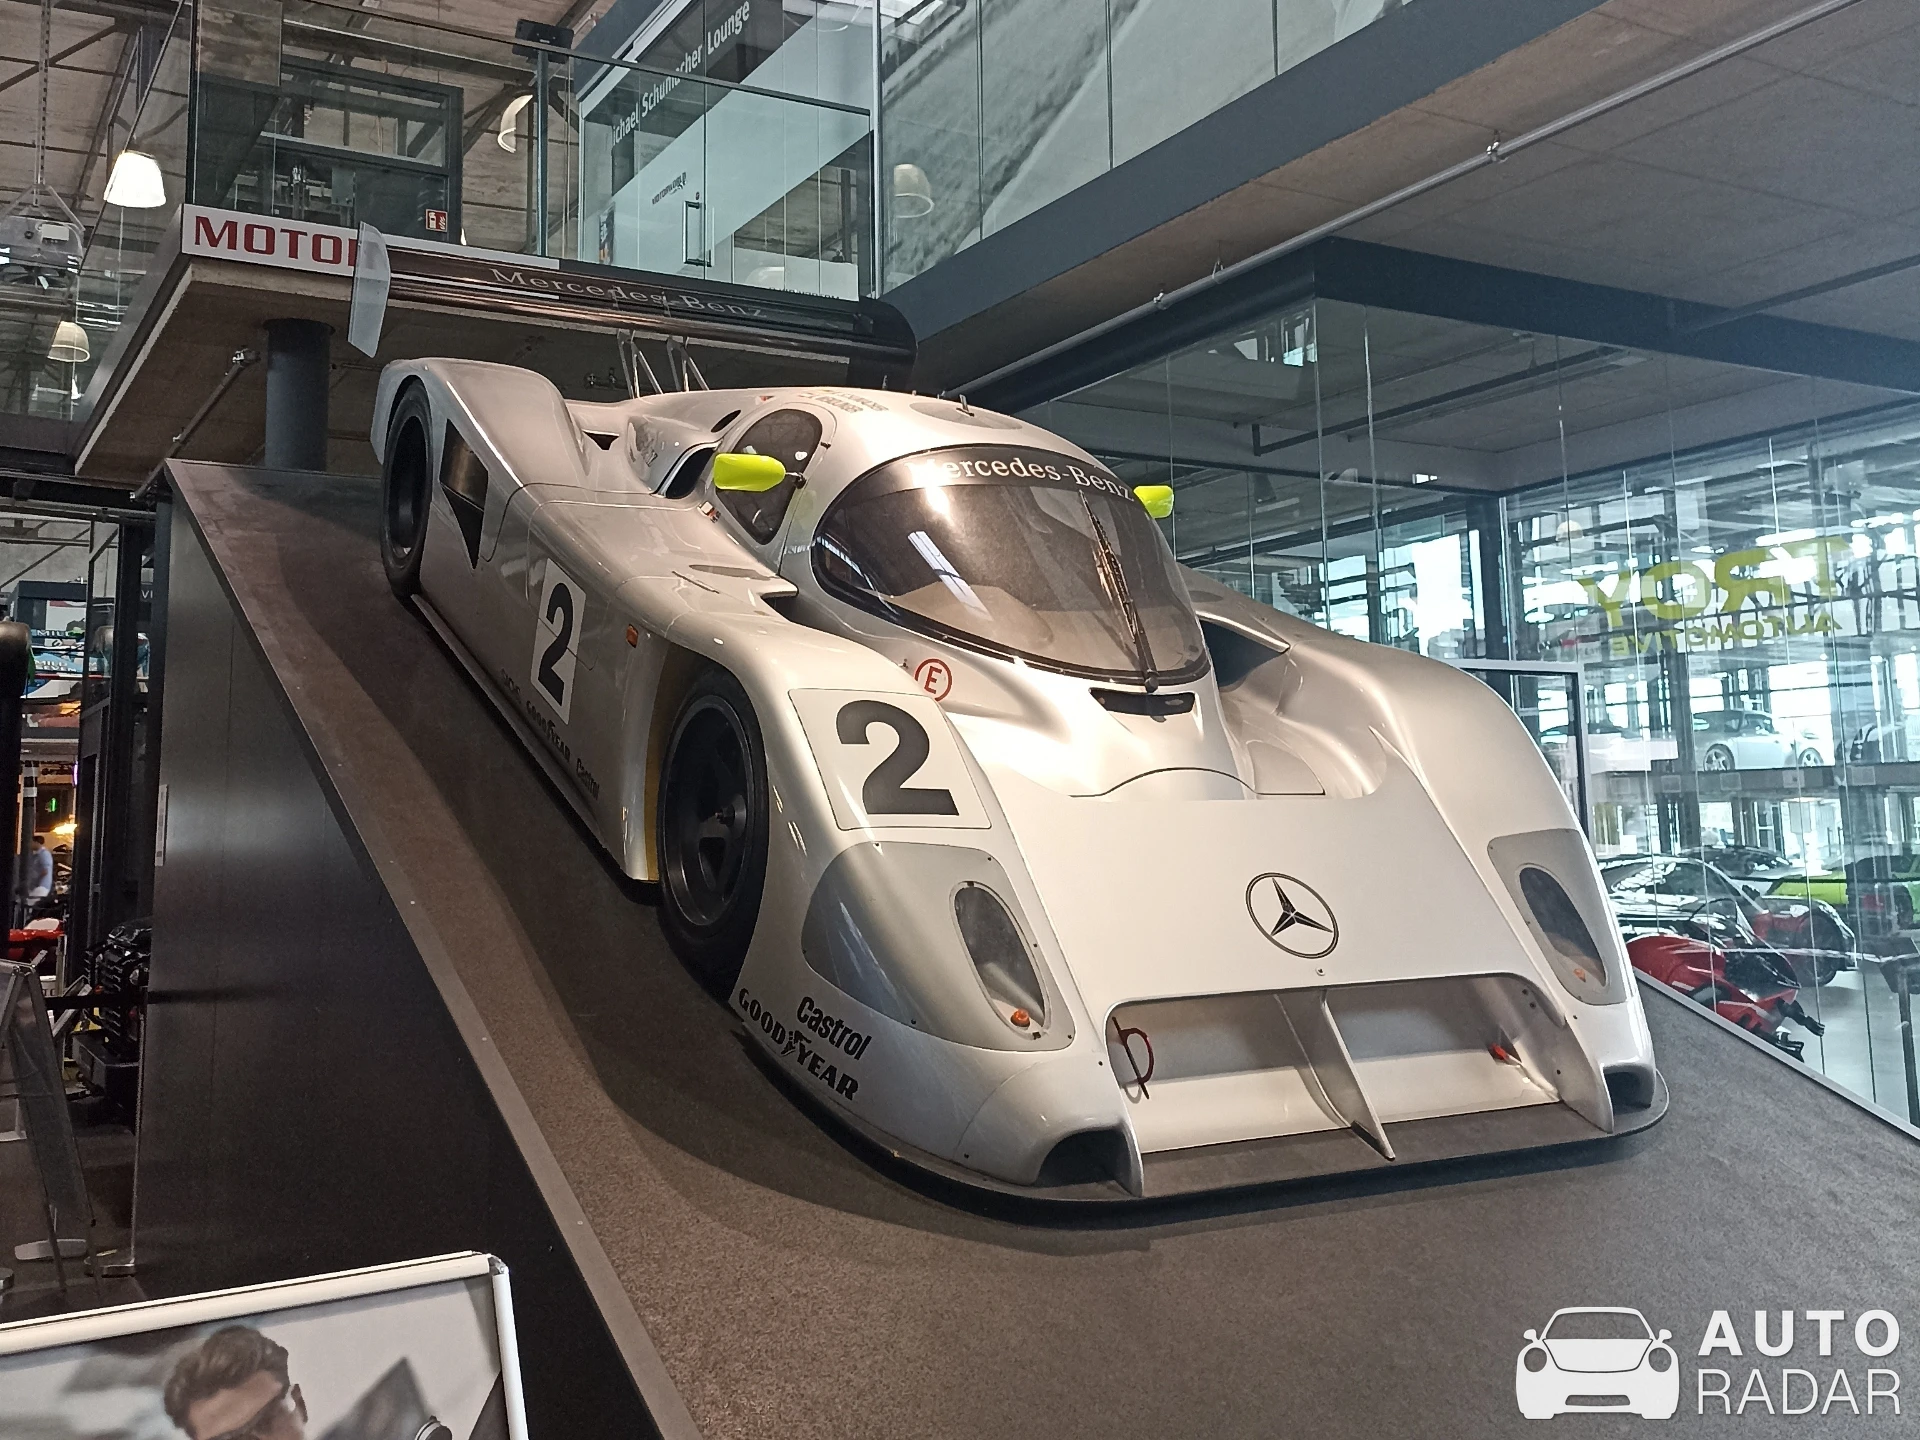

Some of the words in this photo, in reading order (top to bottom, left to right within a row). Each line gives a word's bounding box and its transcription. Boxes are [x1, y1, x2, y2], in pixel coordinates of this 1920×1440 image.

[610, 102, 639, 147] ichael
[707, 1, 750, 55] Lounge
[195, 215, 357, 267] MOTO
[489, 268, 767, 318] Mercedes-Benz
[905, 457, 1135, 502] Mercedes-Benz
[538, 582, 574, 707] 2
[924, 665, 943, 695] E
[836, 699, 960, 816] 2
[796, 996, 873, 1061] Castrol
